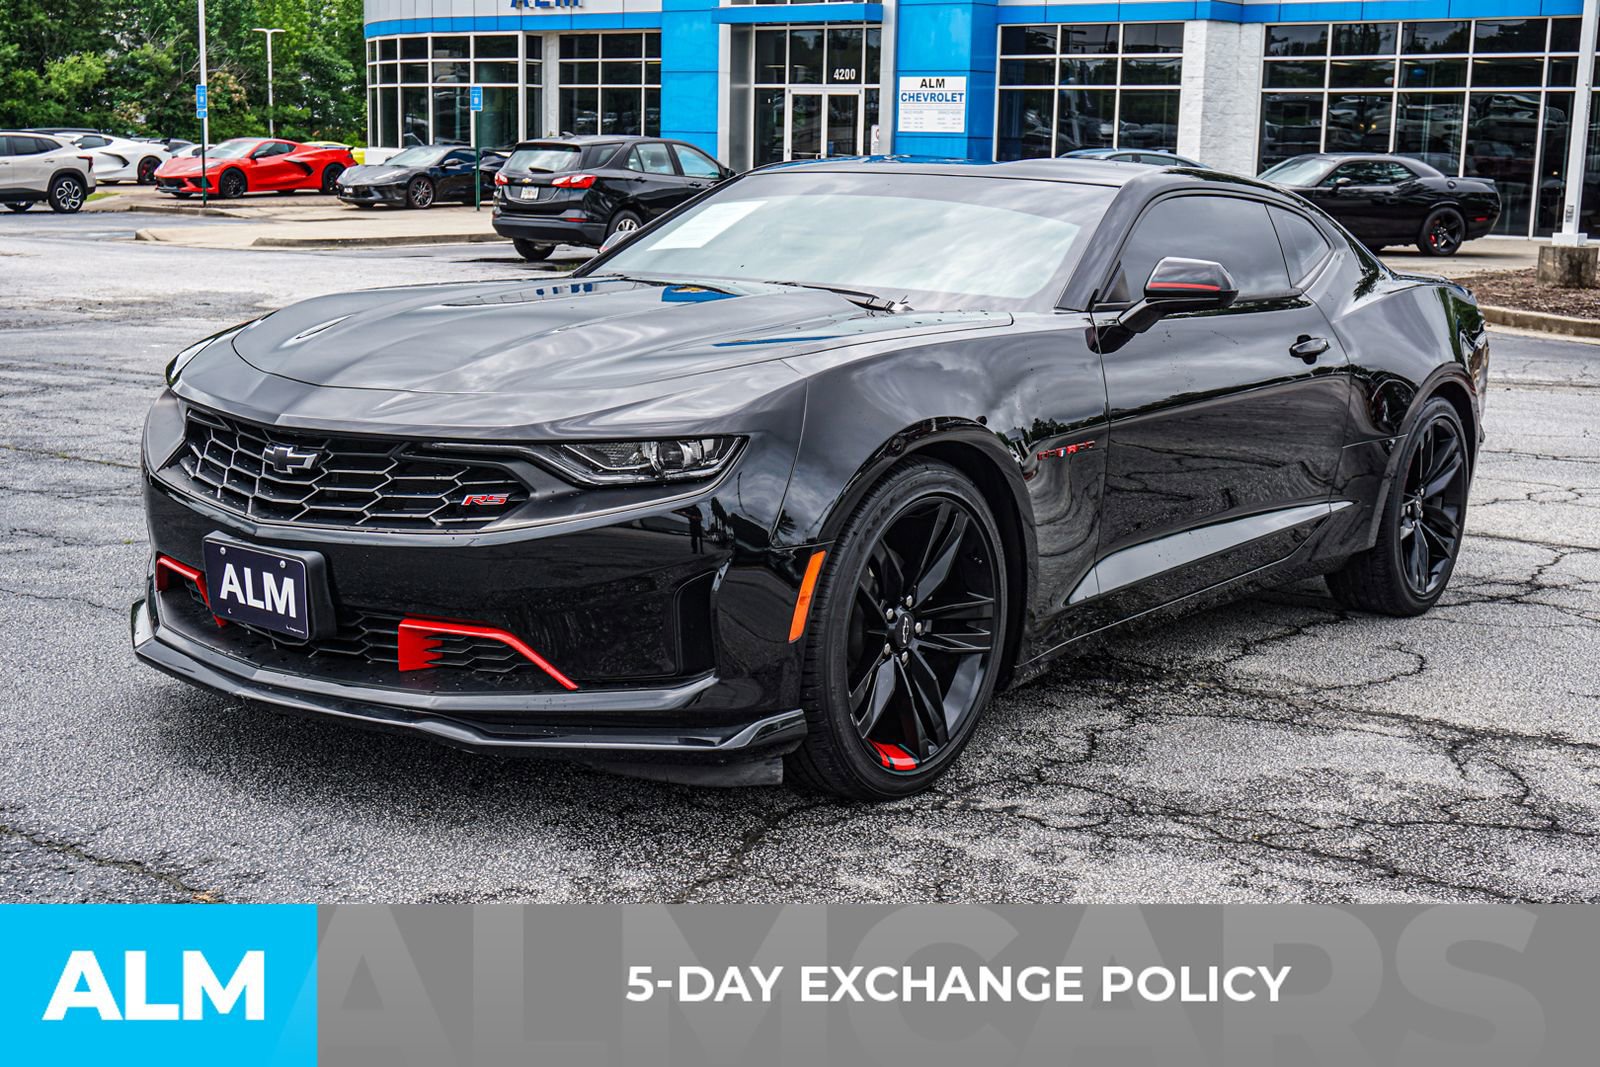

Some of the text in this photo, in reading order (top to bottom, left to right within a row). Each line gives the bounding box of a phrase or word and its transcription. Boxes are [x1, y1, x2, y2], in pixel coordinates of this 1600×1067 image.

[833, 68, 856, 80] 4200
[920, 78, 945, 89] ALM
[900, 92, 965, 103] CHEVROLET
[461, 493, 510, 506] RS
[219, 563, 297, 618] ALM
